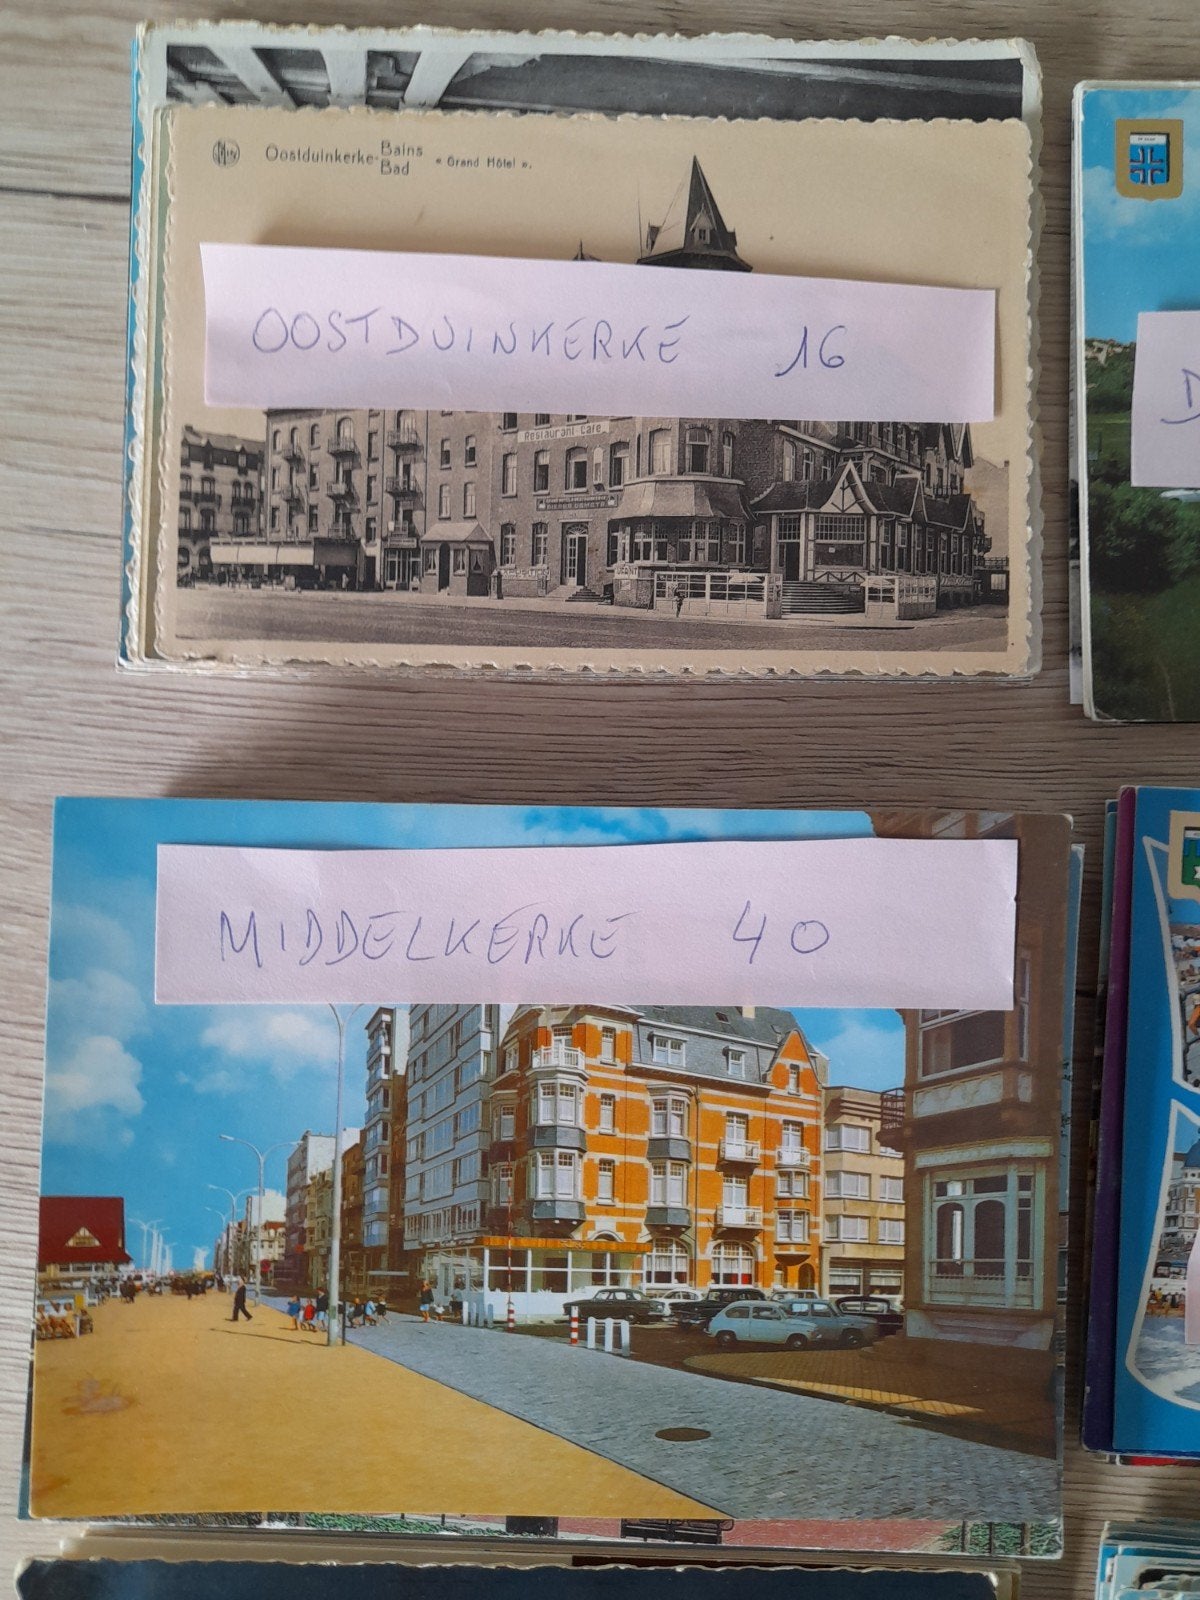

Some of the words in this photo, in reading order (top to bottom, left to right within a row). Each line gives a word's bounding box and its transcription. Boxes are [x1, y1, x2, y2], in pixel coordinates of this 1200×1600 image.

[380, 140, 423, 157] Bains
[447, 156, 479, 168] Grand
[380, 159, 409, 176] Bad
[252, 308, 691, 363] OOSTDUINKERKE
[775, 325, 847, 377] 16
[524, 427, 575, 440] Restaurant
[220, 901, 640, 967] MIDDELKERKE
